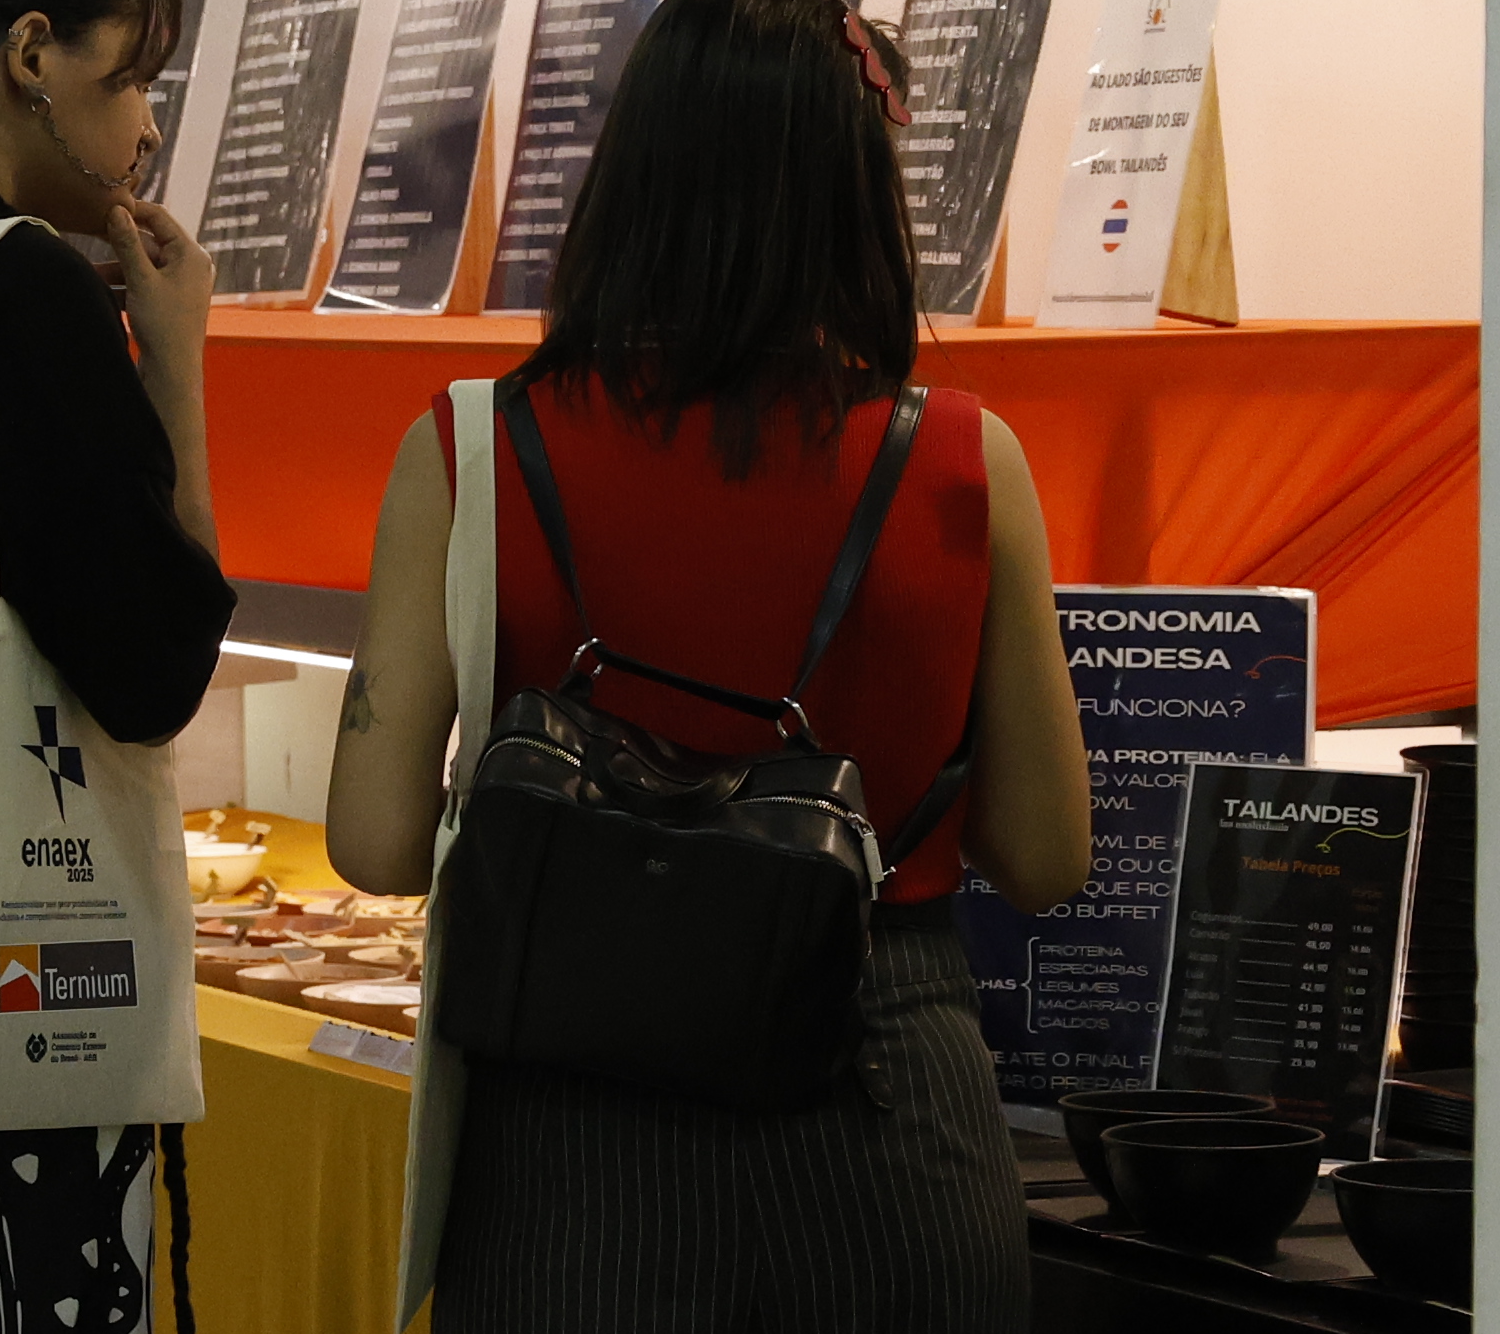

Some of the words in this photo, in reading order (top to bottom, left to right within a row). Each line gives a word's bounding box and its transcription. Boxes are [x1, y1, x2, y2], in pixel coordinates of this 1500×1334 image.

[1090, 72, 1106, 89] AO
[1106, 72, 1132, 88] LADO
[1133, 67, 1152, 86] SÃO
[1152, 63, 1203, 85] SUGESTÕES
[1088, 117, 1101, 132] DE
[1102, 113, 1153, 131] MONTAGEM
[1155, 112, 1170, 128] DO
[1170, 111, 1189, 128] SEU
[1090, 159, 1118, 175] BOWL
[1120, 152, 1168, 173] TAILANDÊS
[1056, 609, 1262, 634] TRONOMIA
[1069, 647, 1232, 671] ANDESA
[1077, 698, 1247, 719] FUNCIONA?
[1113, 774, 1189, 787] VALOR
[1090, 797, 1135, 810] OWL
[1223, 799, 1379, 827] TAILANDES
[1091, 835, 1129, 849] WL
[1135, 835, 1166, 849] DE
[21, 837, 94, 867] enaex
[1118, 858, 1153, 872] OU
[1241, 855, 1289, 874] Tabela
[1293, 859, 1342, 878] Preços
[66, 868, 94, 882] 2025
[1083, 880, 1131, 899] QUE
[1136, 882, 1171, 898] FIC
[1076, 904, 1161, 920] BUFFET
[1039, 946, 1125, 958] PROTEINA
[1039, 962, 1149, 977] ESPECIARIAS
[44, 965, 130, 1001] Ternium
[1038, 981, 1120, 994] LEGUMES
[1037, 1017, 1111, 1030] CALDOS
[1052, 1053, 1070, 1067] O
[1075, 1054, 1135, 1069] FINAL
